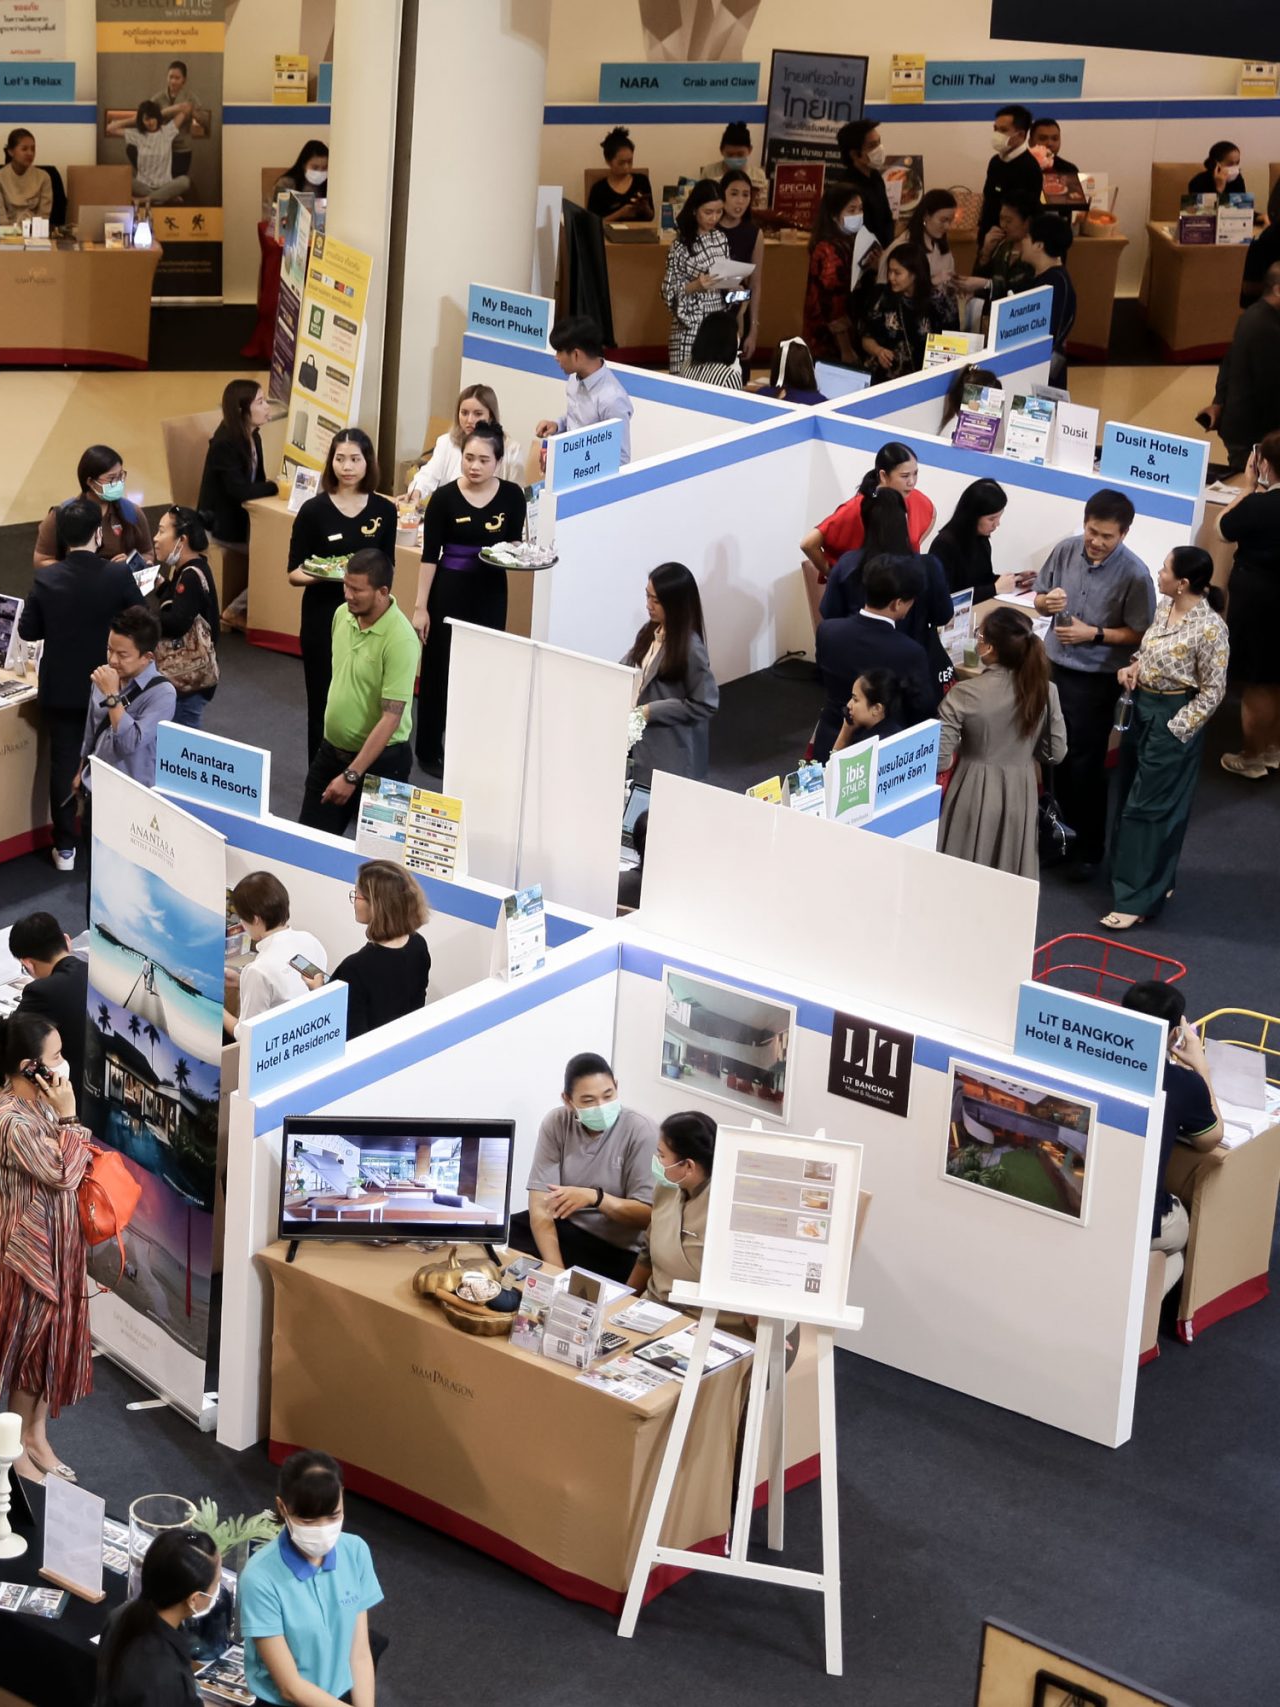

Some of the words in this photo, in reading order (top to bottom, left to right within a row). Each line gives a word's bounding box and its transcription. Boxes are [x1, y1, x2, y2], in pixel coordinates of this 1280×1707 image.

[4, 76, 29, 86] Let's
[32, 76, 62, 86] Relax
[620, 77, 659, 89] NARA
[683, 77, 708, 87] Crab
[709, 77, 728, 87] and
[731, 76, 756, 87] Claw
[932, 74, 965, 86] Chilli
[968, 74, 995, 86] Thai
[1009, 74, 1038, 86] Wang
[1041, 74, 1056, 83] Jia
[1058, 73, 1078, 83] Sha
[782, 87, 854, 122] ไทยเท่
[779, 183, 817, 193] SPECIAL
[482, 297, 498, 311] My
[500, 301, 532, 317] Beach
[1009, 302, 1041, 319] Anantara
[472, 312, 505, 328] Resort
[507, 320, 543, 337] Phuket
[1000, 323, 1029, 339] Vacation
[1030, 316, 1047, 330] Club
[563, 438, 585, 453] Dusit
[586, 430, 613, 446] Hotels
[1061, 424, 1089, 440] Dusit
[1115, 431, 1147, 449] Dusit
[1149, 439, 1189, 457] Hotels
[584, 450, 591, 461] &
[1147, 454, 1156, 466] &
[573, 462, 600, 479] Resort
[1130, 465, 1170, 484] Resort
[180, 747, 235, 773] Anantara
[878, 754, 914, 777] งแรมไอบิส
[160, 759, 197, 780] Hotels
[200, 772, 208, 784] &
[211, 775, 258, 798] Resorts
[846, 762, 865, 783] ibis
[129, 822, 175, 858] ANANTARA
[282, 1013, 331, 1045] BANGKOK
[1062, 1018, 1135, 1051] BANGKOK
[256, 1052, 281, 1073] Hotel
[283, 1049, 290, 1060] &
[292, 1027, 340, 1056] Residence
[1025, 1024, 1060, 1045] Hotel
[1063, 1037, 1072, 1049] &
[1076, 1040, 1148, 1072] Residence
[854, 1078, 895, 1098] BANGKOK
